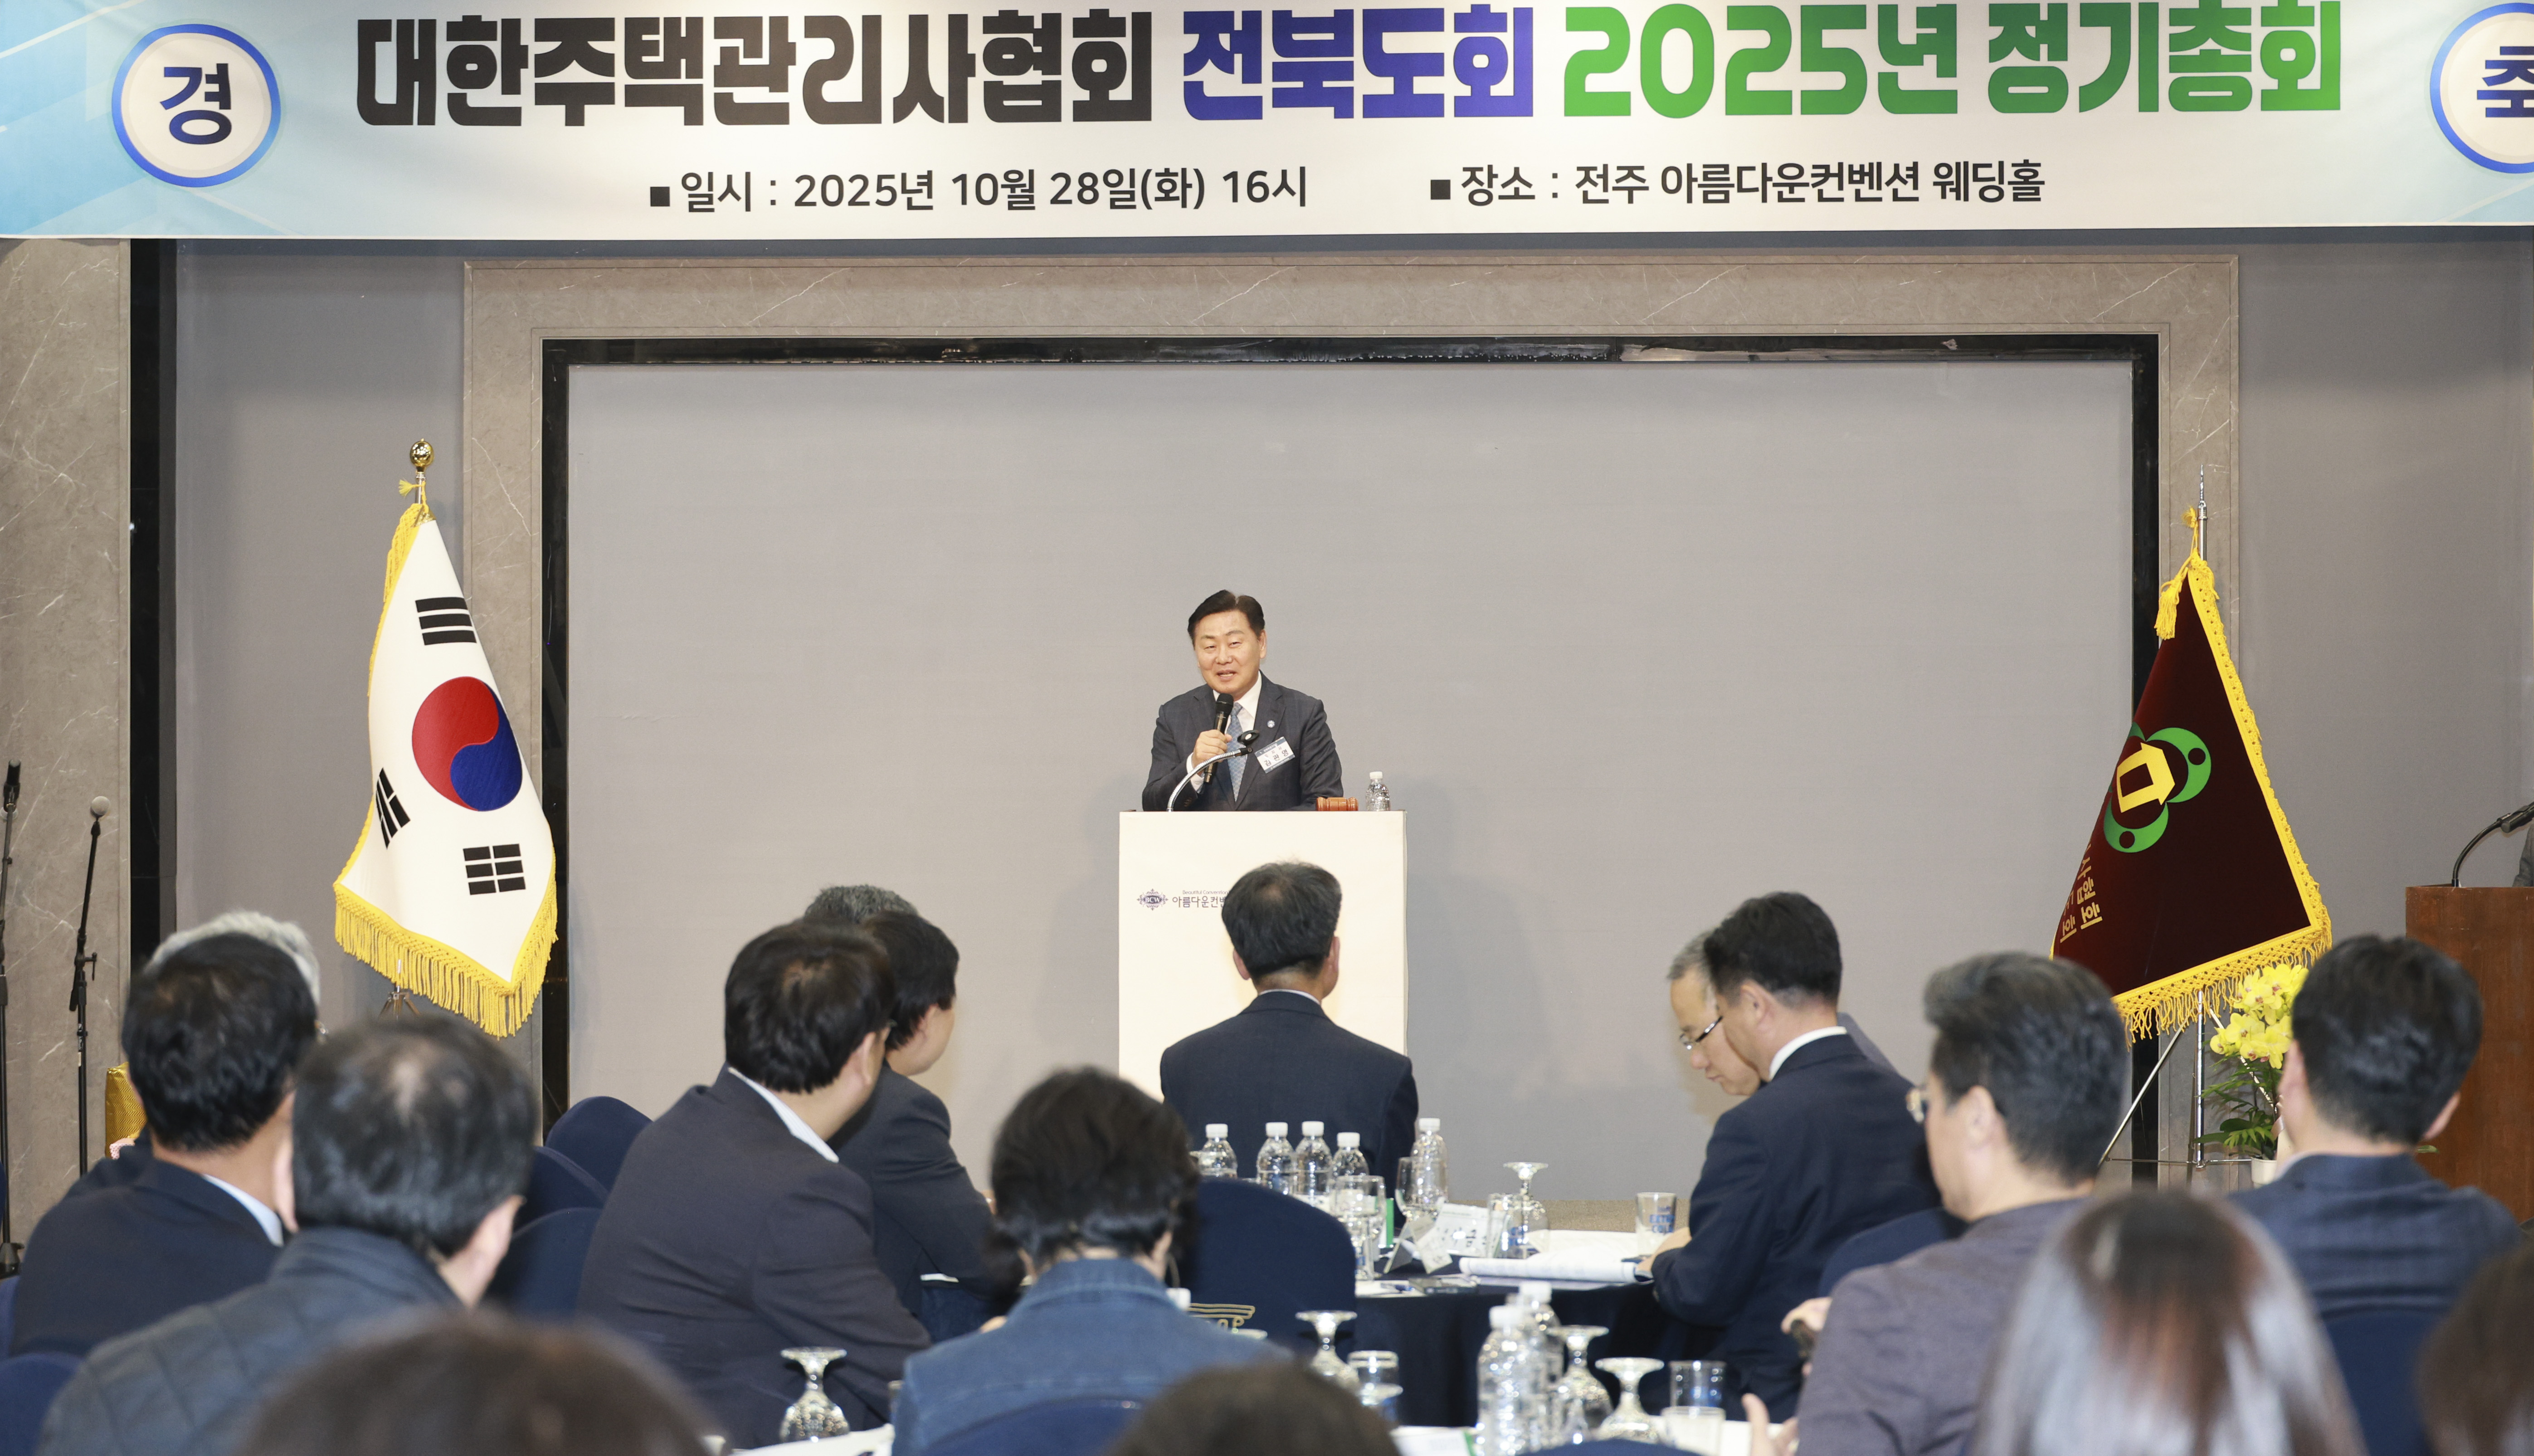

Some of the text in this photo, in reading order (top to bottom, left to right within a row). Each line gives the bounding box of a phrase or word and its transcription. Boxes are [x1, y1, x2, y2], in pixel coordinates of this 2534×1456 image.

[357, 0, 2340, 127] 대한주택관리사협회 전북도회 2025년 정기총회
[162, 63, 232, 145] 경
[682, 171, 751, 213] 일시
[794, 169, 934, 210] 2025년
[952, 169, 1036, 210] 10월
[1050, 168, 1204, 210] 28일(화)
[1223, 166, 1306, 207] 16시
[1461, 165, 1535, 206] 장소
[1576, 164, 1649, 204] 전주
[1662, 161, 1920, 204] 아름다운컨벤션
[1932, 159, 2045, 202] 웨딩홀
